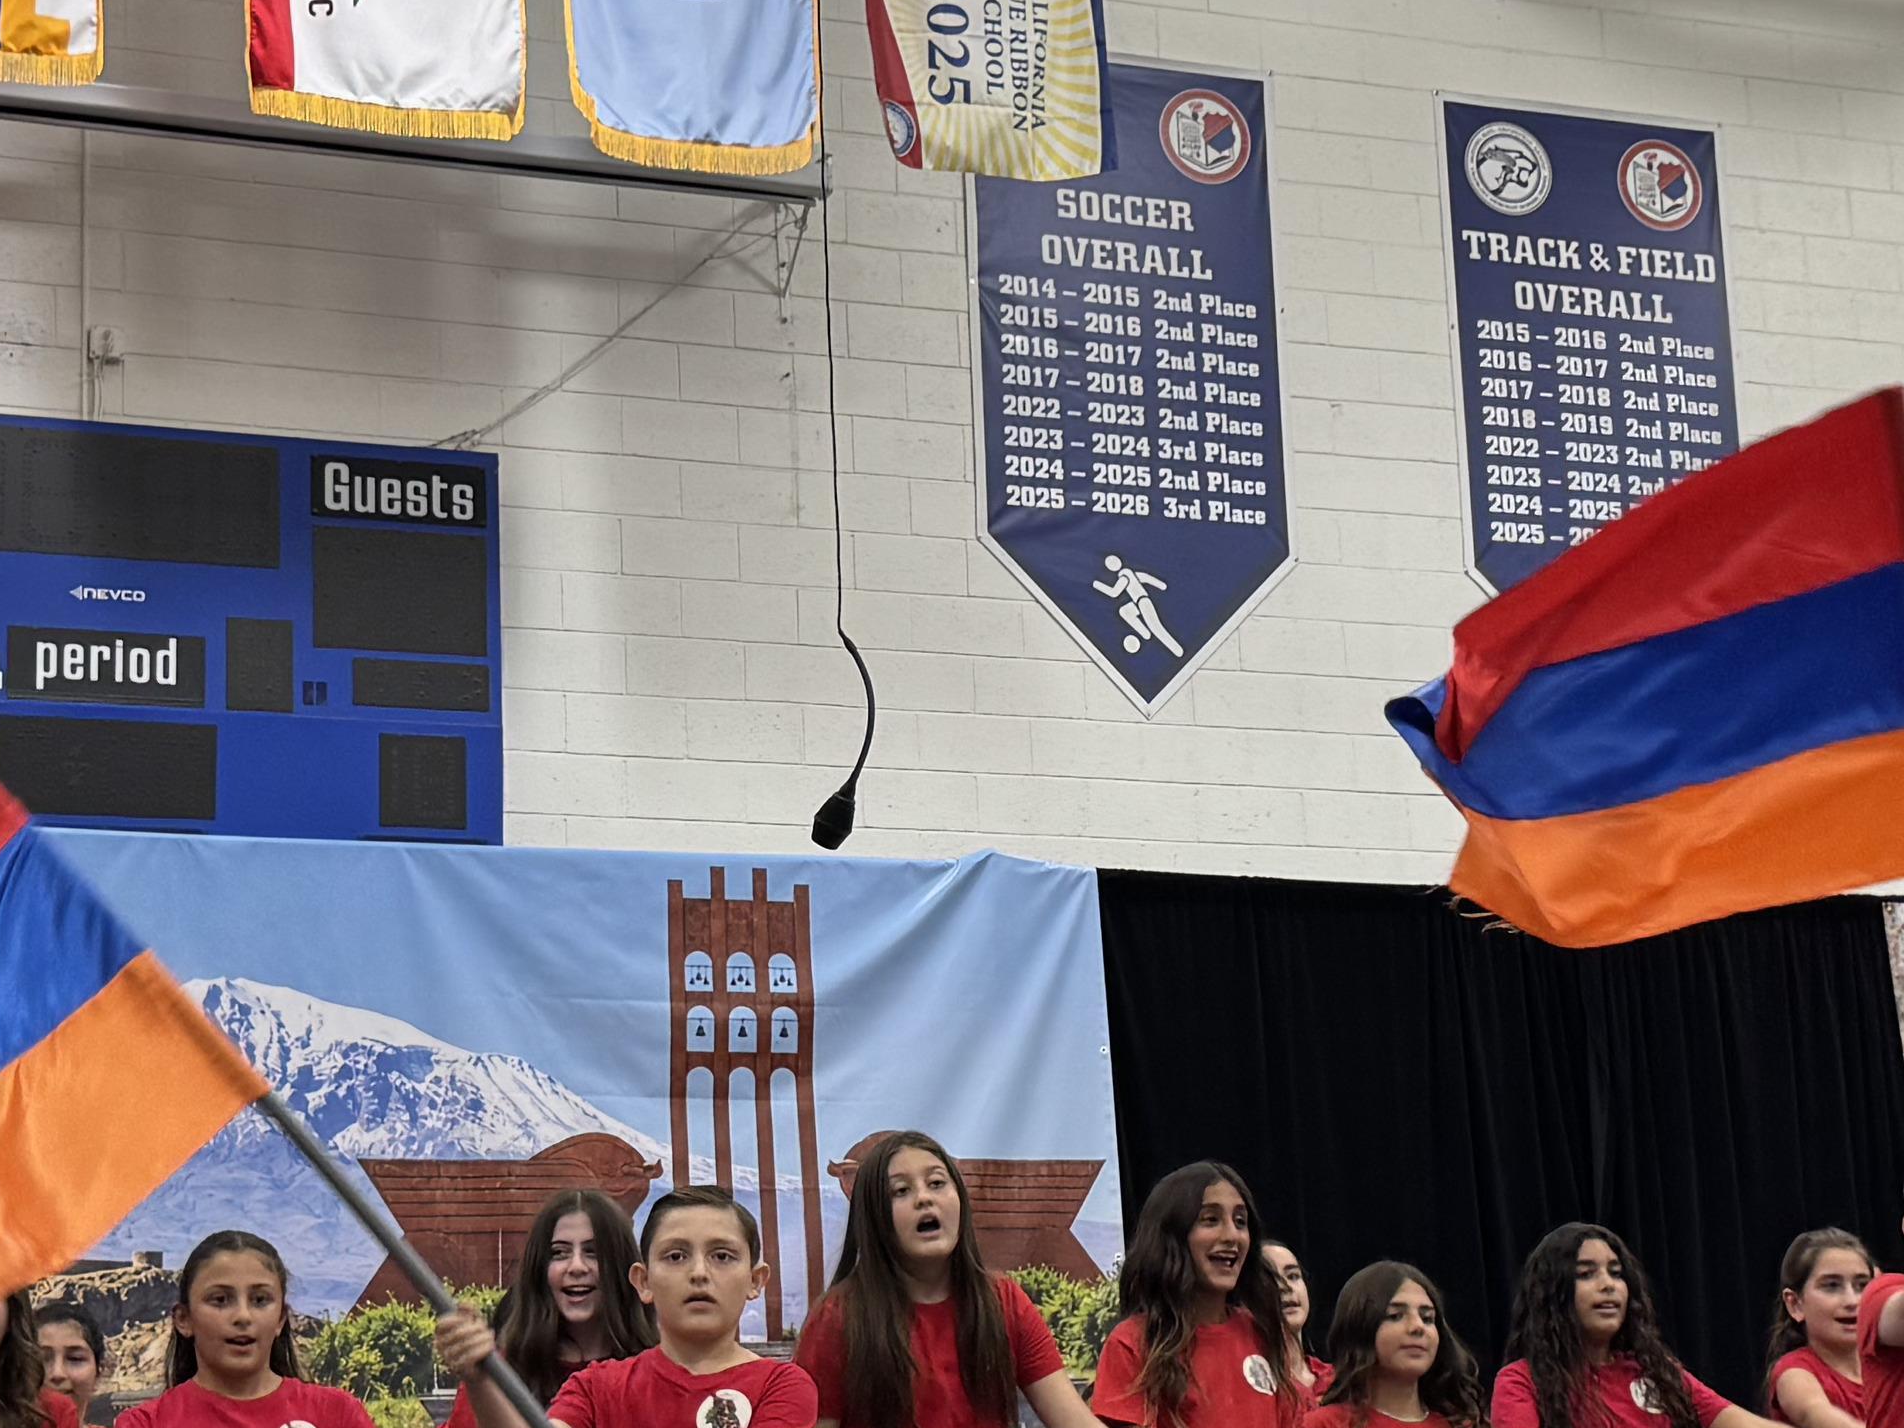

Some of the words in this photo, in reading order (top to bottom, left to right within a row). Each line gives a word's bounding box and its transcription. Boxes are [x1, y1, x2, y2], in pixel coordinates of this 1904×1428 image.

[1009, 28, 1029, 133] RIBBON
[1057, 188, 1194, 231] SOCCER
[1041, 234, 1212, 280] OVERALL
[1462, 230, 1582, 270] TRACK
[1589, 243, 1611, 272] &
[1617, 246, 1716, 283] FIELD
[999, 274, 1056, 299] 2014
[1083, 282, 1139, 307] 2015
[1153, 289, 1193, 312] 2nd
[1199, 294, 1256, 318] Place
[1515, 281, 1673, 324] OVERALL
[1000, 304, 1058, 328] 2015
[1084, 312, 1141, 336] 2016
[1155, 319, 1195, 342] 2nd
[1201, 323, 1258, 348] Place
[1477, 320, 1530, 343] 2015
[1554, 327, 1606, 350] 2016
[1619, 333, 1656, 355] 2nd
[1661, 337, 1714, 360] Place
[1001, 333, 1058, 358] 2016
[1085, 342, 1142, 366] 2017
[1156, 348, 1196, 371] 2nd
[1202, 352, 1259, 377] Place
[1479, 348, 1532, 371] 2016
[1556, 355, 1608, 378] 2017
[1621, 361, 1658, 383] 2nd
[1663, 365, 1717, 388] Place
[1002, 364, 1059, 388] 2017
[1086, 372, 1144, 396] 2018
[1157, 378, 1197, 401] 2nd
[1204, 382, 1261, 407] Place
[1481, 377, 1533, 400] 2017
[1558, 384, 1611, 407] 2018
[1623, 390, 1660, 411] 2nd
[1666, 393, 1719, 416] Place
[1003, 394, 1061, 419] 2022
[1088, 402, 1144, 426] 2023
[1159, 408, 1199, 431] 2nd
[1205, 412, 1263, 436] Place
[1482, 406, 1536, 429] 2018
[1561, 412, 1613, 435] 2019
[1626, 418, 1663, 440] 2nd
[1668, 422, 1722, 444] Place
[1004, 425, 1063, 450] 2023
[1092, 433, 1150, 457] 2024
[1158, 438, 1197, 461] 3rd
[1204, 442, 1263, 467] Place
[1485, 435, 1540, 458] 2022
[1565, 442, 1619, 464] 2023
[1625, 447, 1663, 468] 2nd
[323, 461, 475, 521] Guests
[1005, 455, 1064, 480] 2024
[1093, 463, 1151, 487] 2025
[1159, 468, 1200, 491] 2nd
[1207, 471, 1266, 495] Place
[1487, 465, 1541, 487] 2023
[1567, 471, 1621, 493] 2024
[1006, 485, 1065, 509] 2025
[1092, 491, 1149, 515] 2026
[1163, 497, 1202, 520] 3rd
[1208, 500, 1266, 525] Place
[1488, 493, 1543, 516] 2024
[1569, 499, 1622, 521] 2025
[1490, 521, 1545, 544] 2025
[36, 637, 177, 690] period
